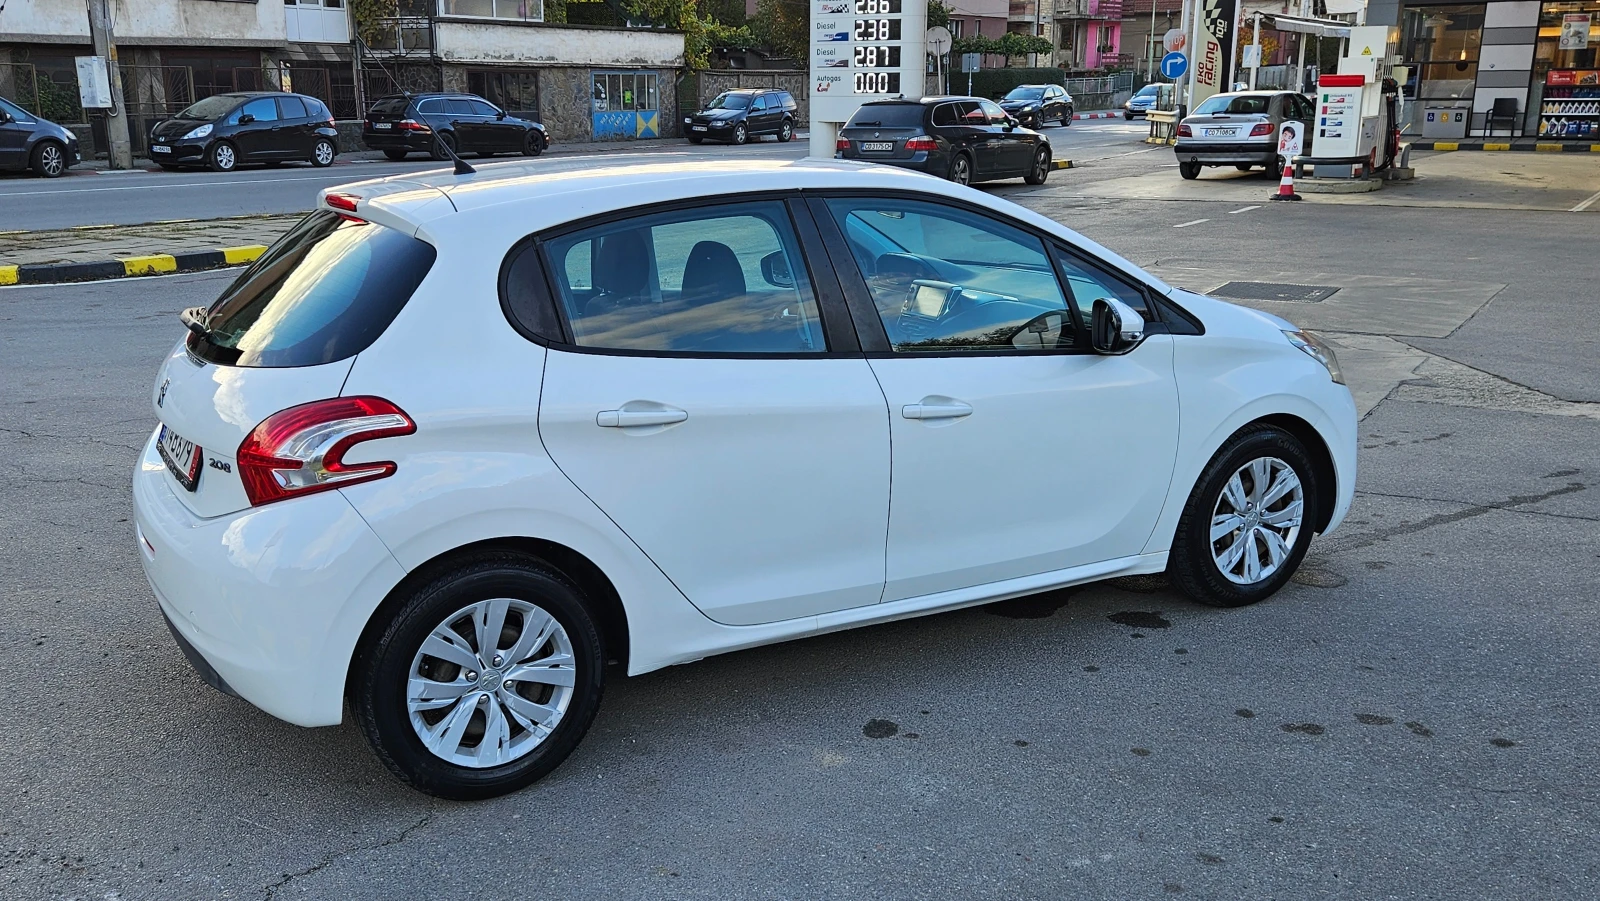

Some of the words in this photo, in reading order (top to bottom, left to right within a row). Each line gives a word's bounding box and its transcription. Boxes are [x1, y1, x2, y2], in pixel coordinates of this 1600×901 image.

[855, 0, 890, 14] 2.86
[816, 21, 836, 30] Diesel
[854, 20, 889, 41] 2.38
[1215, 18, 1225, 38] 100
[816, 48, 836, 56] Diesel
[854, 46, 889, 67] 2.87
[1196, 61, 1205, 84] EKO
[1203, 40, 1219, 87] racing
[816, 75, 842, 84] Autogas
[854, 73, 889, 93] 0.00
[208, 457, 232, 474] 208
